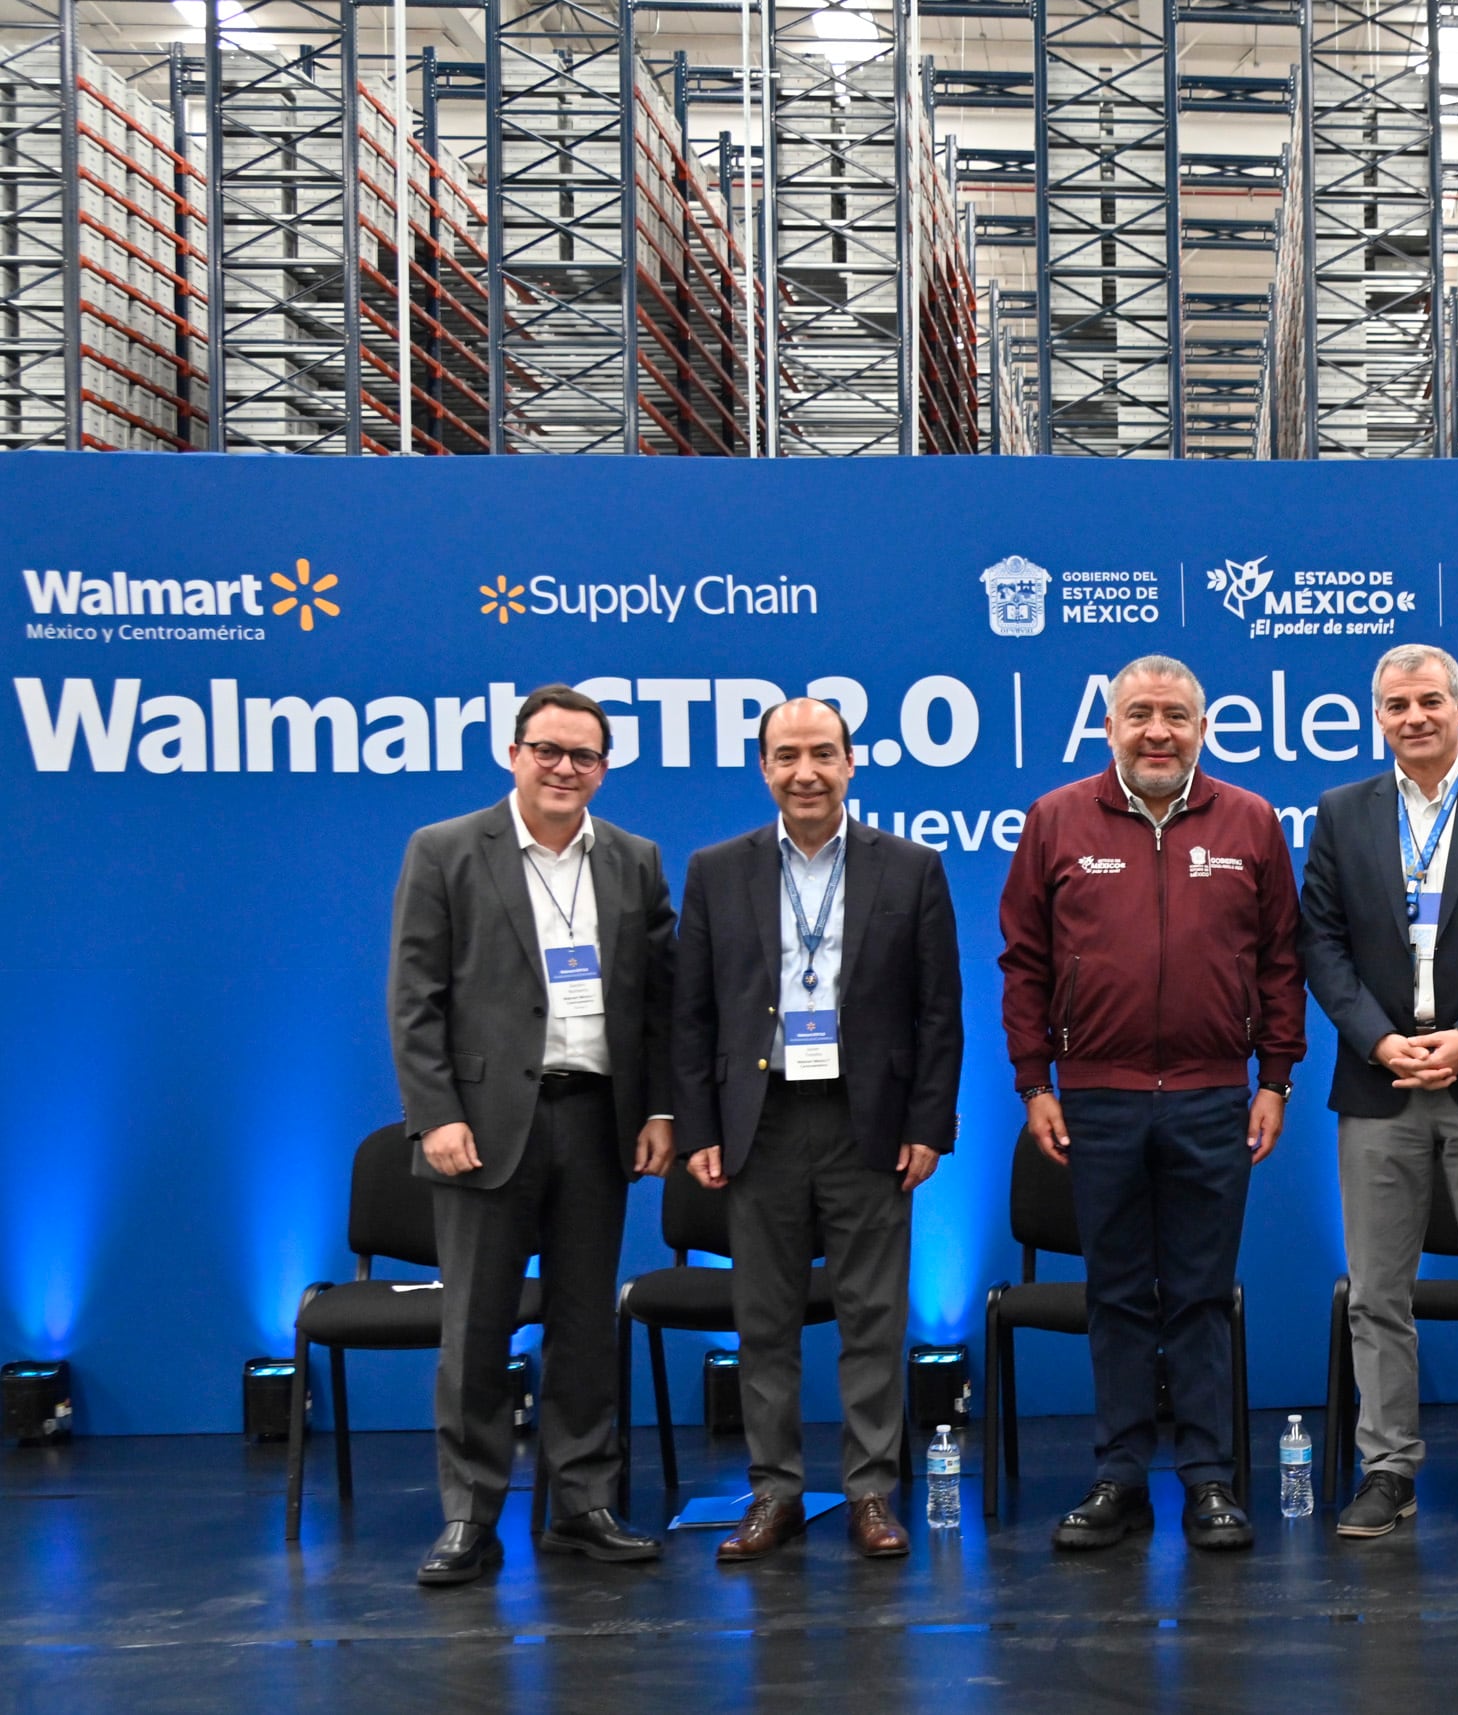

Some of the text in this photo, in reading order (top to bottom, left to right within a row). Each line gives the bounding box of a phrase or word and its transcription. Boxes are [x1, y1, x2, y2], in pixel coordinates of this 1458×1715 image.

[1062, 571, 1158, 582] GOBIERNO DEL
[1294, 571, 1393, 586] ESTADO DE
[23, 569, 264, 616] Walmart
[529, 574, 818, 624] Supply Chain
[1062, 586, 1159, 600] ESTADO DE
[1264, 588, 1394, 615] MÉXICO
[1062, 601, 1159, 624] MÉXICO
[26, 623, 265, 643] México y Centroamérica
[1250, 617, 1395, 639] ¡El poder de servir!
[13, 678, 529, 774] Walmart
[806, 675, 980, 768] 2.0
